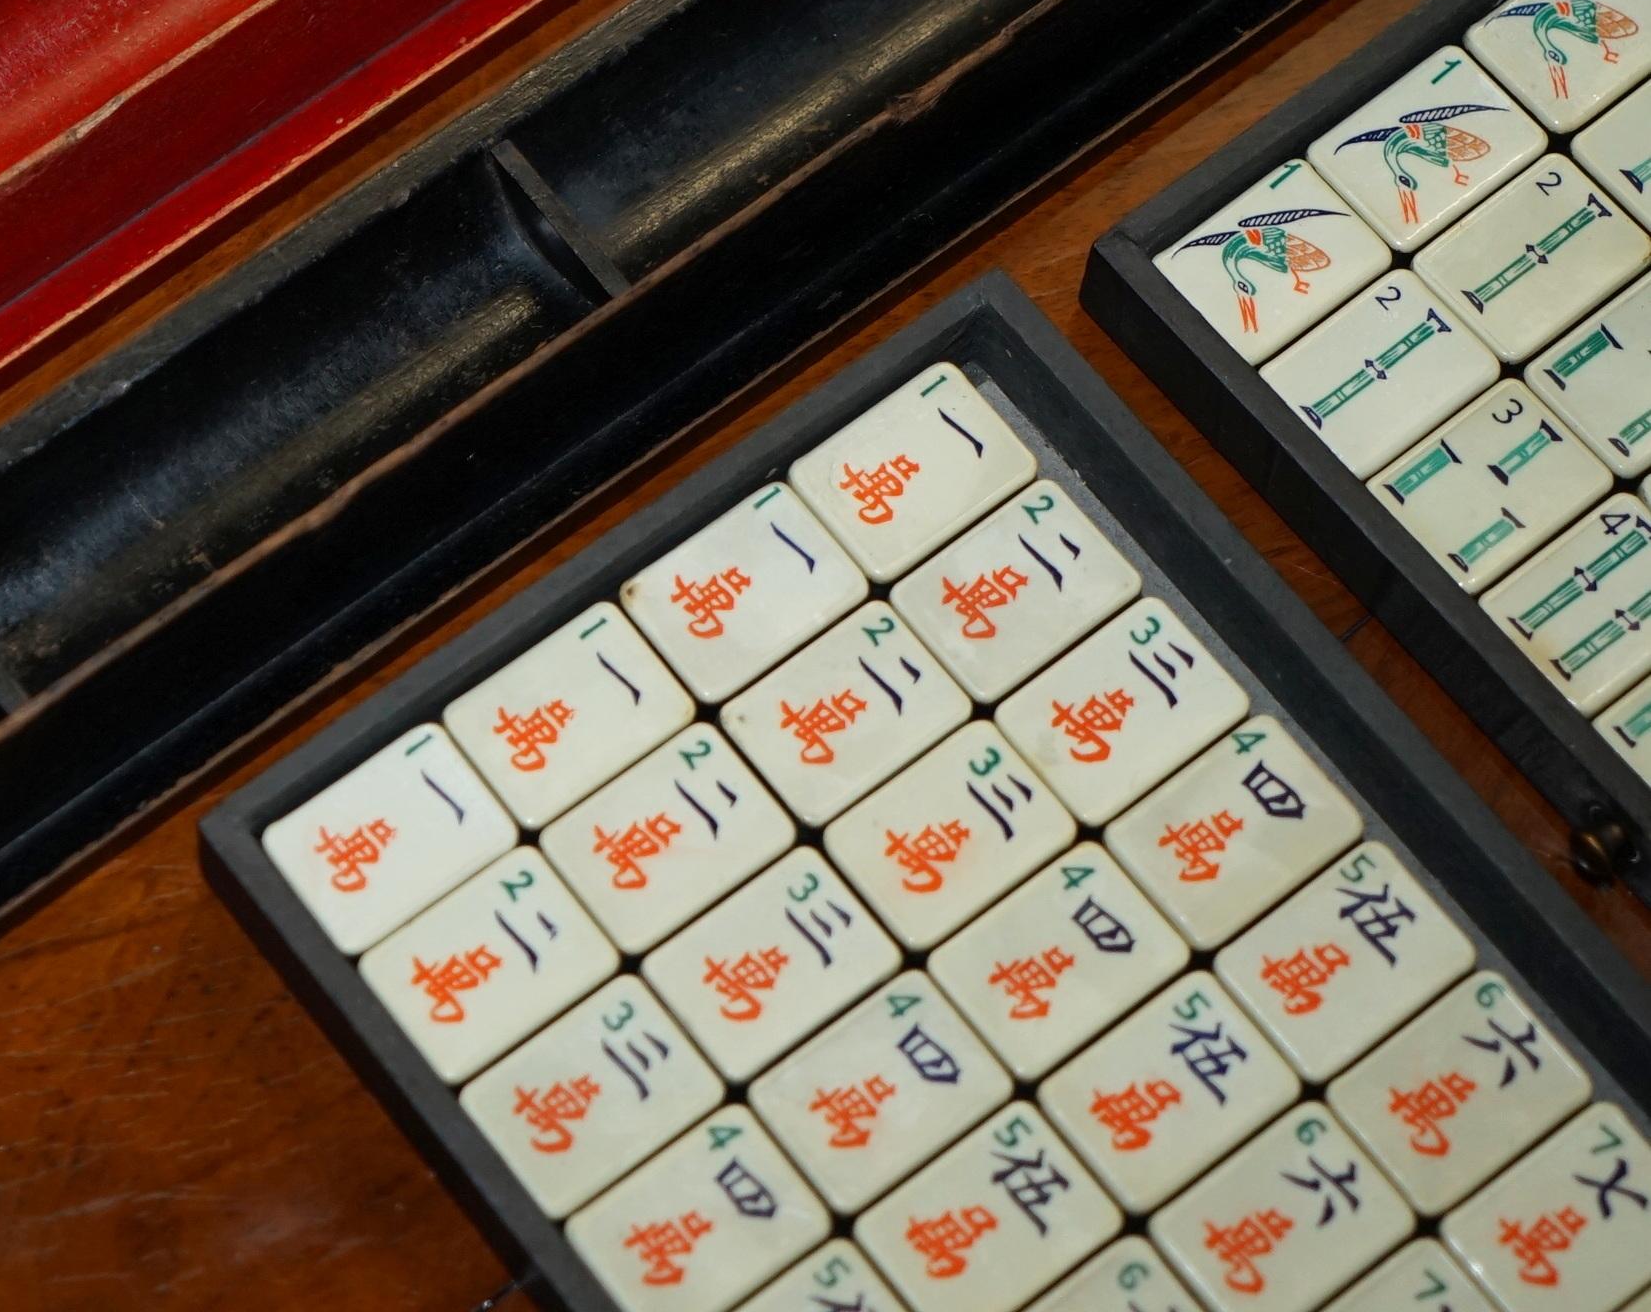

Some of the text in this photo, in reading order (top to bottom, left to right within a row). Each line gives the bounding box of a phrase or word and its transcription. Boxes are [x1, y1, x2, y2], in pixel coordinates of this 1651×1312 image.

[1431, 59, 1463, 85] 1
[1270, 163, 1302, 189] 1
[1536, 172, 1562, 196] 2
[1375, 286, 1401, 312] 2
[919, 375, 948, 399] 1
[1492, 398, 1524, 424] 3
[753, 486, 782, 509] 1
[1021, 494, 1054, 526] 2
[1600, 512, 1632, 536] 4
[580, 618, 607, 640] 1
[866, 617, 895, 647] 2
[1130, 616, 1162, 646] 3
[406, 734, 434, 756] 1
[679, 740, 711, 770] 2
[1231, 731, 1266, 755] 4
[969, 748, 1001, 776] 3
[1059, 865, 1096, 890] 4
[1339, 854, 1375, 883] 5
[499, 870, 535, 902] 2
[787, 873, 818, 902] 3
[886, 991, 922, 1018] 4
[1174, 992, 1213, 1021] 5
[1474, 982, 1505, 1008] 6
[602, 1001, 634, 1030] 3
[706, 1125, 743, 1152] 4
[993, 1117, 1031, 1148] 5
[1295, 1117, 1327, 1147] 6
[1592, 1123, 1623, 1155] 7
[813, 1256, 851, 1287] 5
[1117, 1262, 1148, 1289] 6
[1415, 1269, 1447, 1300] 7
